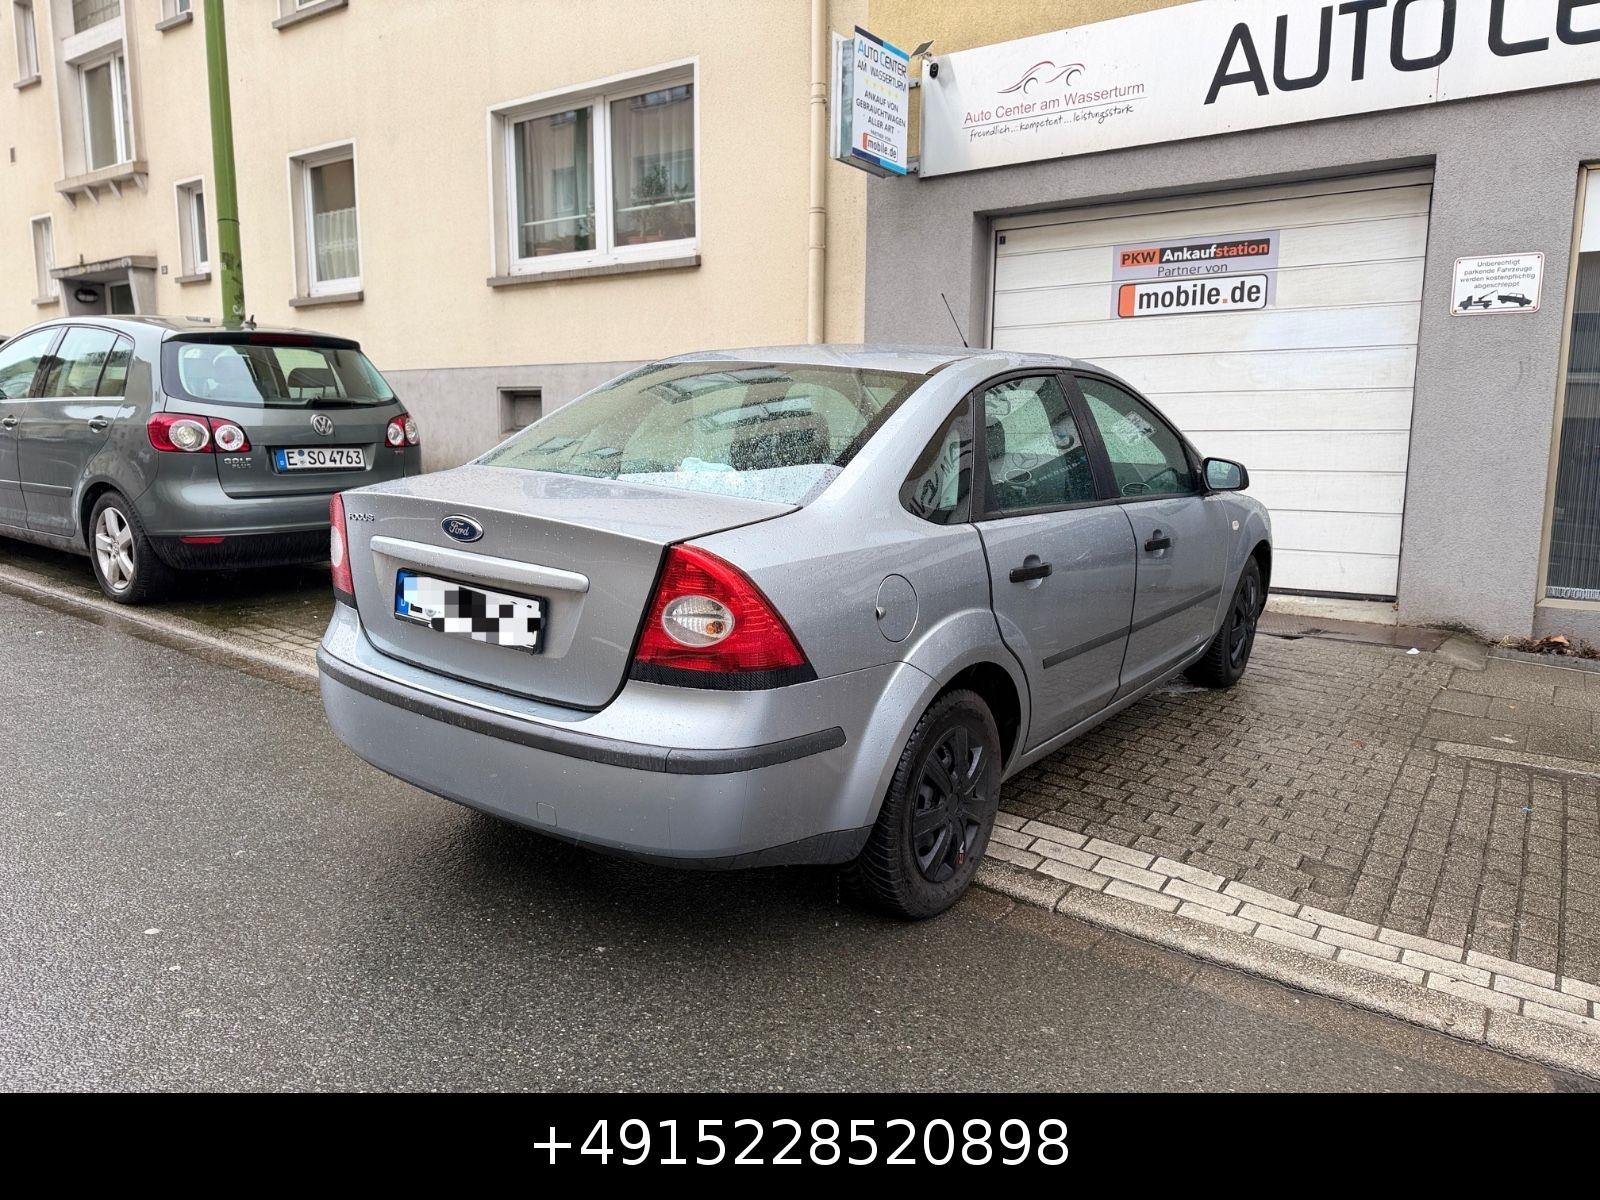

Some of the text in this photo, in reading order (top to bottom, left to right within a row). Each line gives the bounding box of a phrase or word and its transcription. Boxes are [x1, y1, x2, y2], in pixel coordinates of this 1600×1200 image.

[858, 40, 907, 78] AUTO CENTER
[1203, 0, 1456, 105] AUTO
[857, 60, 907, 92] AM WASSERTURM
[864, 89, 899, 113] ANKAUF VON
[964, 83, 1145, 124] Auto Center am Wasserturm
[855, 98, 906, 128] GEBRAUCHTWAGEN
[867, 116, 895, 134] ALLER ART
[868, 139, 897, 159] mobile.de
[1121, 242, 1269, 265] PKW Ankaufstation
[1157, 263, 1228, 277] Partner von
[1463, 266, 1533, 276] parkende Fahrzeuge
[1477, 259, 1521, 268] Unberechtigt
[1474, 281, 1520, 289] abgeschleppt
[1485, 273, 1536, 281] kostenpflichtig
[1138, 280, 1261, 310] mobile.de
[223, 457, 253, 465] GOLF
[329, 450, 362, 465] 4763
[349, 512, 375, 522] FOCUS
[448, 520, 470, 537] Ford
